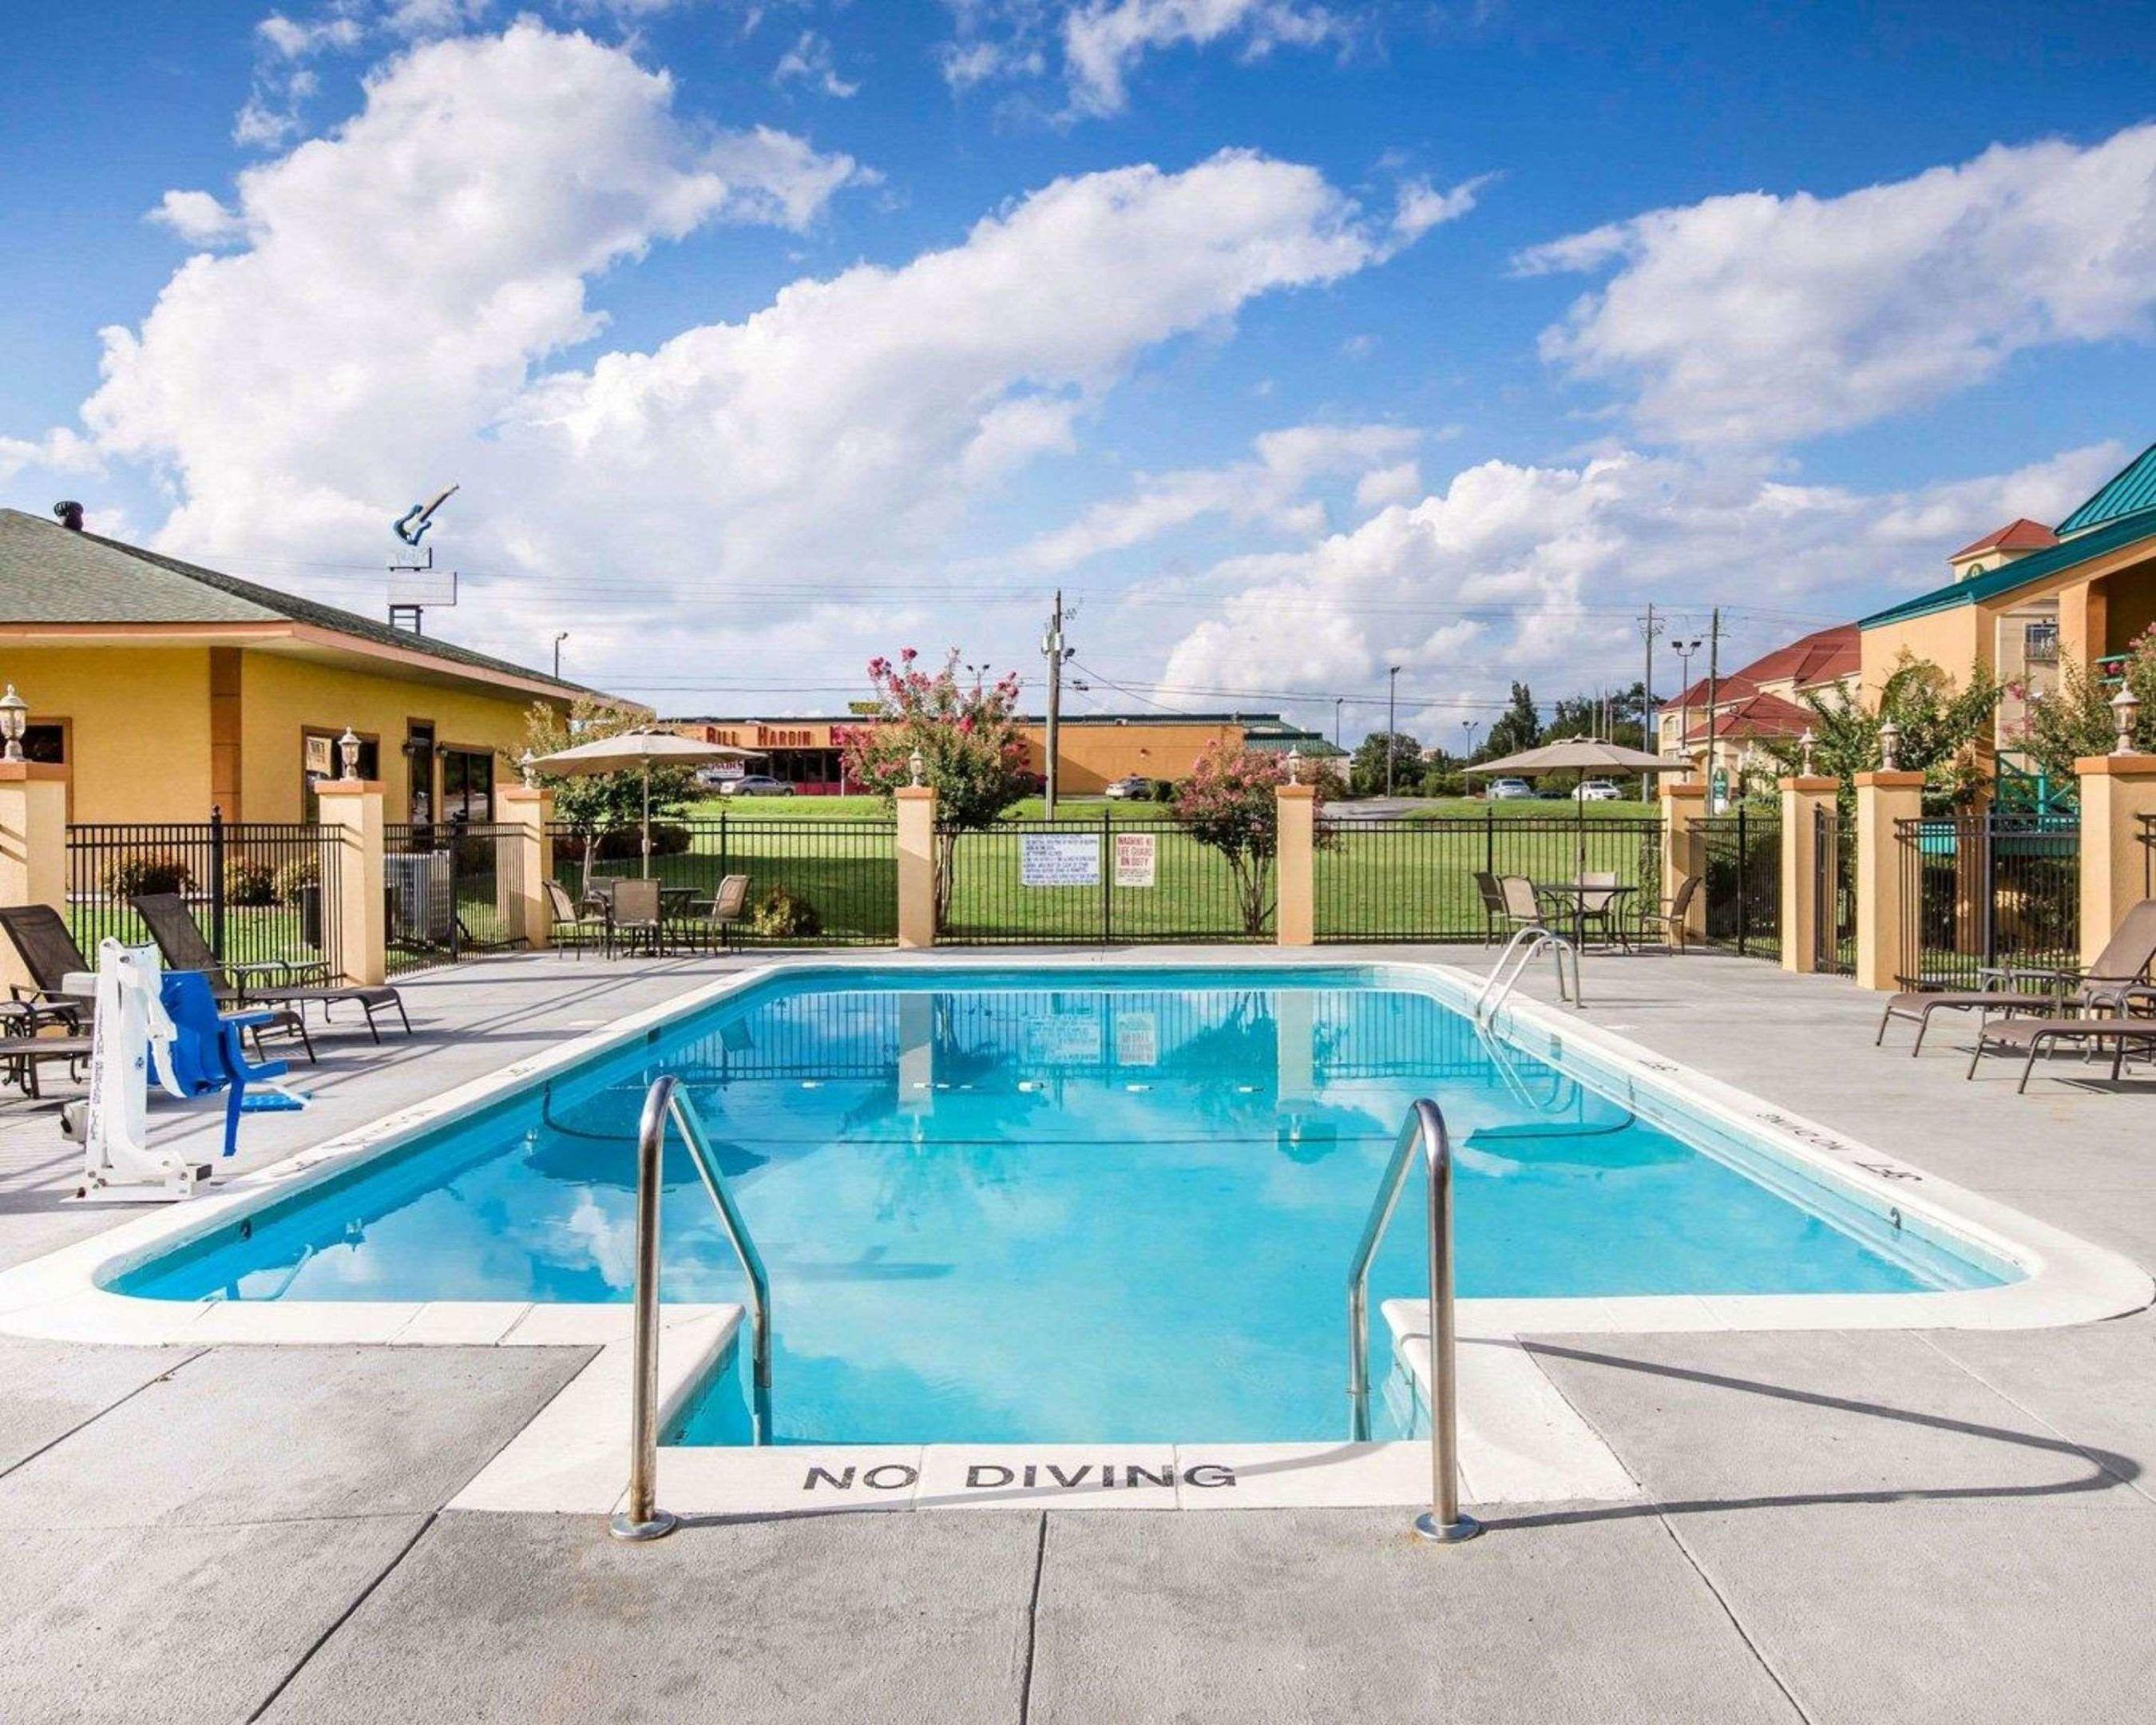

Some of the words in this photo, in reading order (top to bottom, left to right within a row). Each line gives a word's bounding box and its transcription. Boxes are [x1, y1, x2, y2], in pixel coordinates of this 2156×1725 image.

[758, 726, 810, 746] HARDIN
[1118, 846, 1129, 856] LIFE
[1131, 847, 1153, 856] GUARD
[1120, 856, 1130, 866] ON
[1132, 857, 1149, 866] DUTY
[803, 1465, 918, 1489] NO
[965, 1465, 1236, 1488] DIVING
